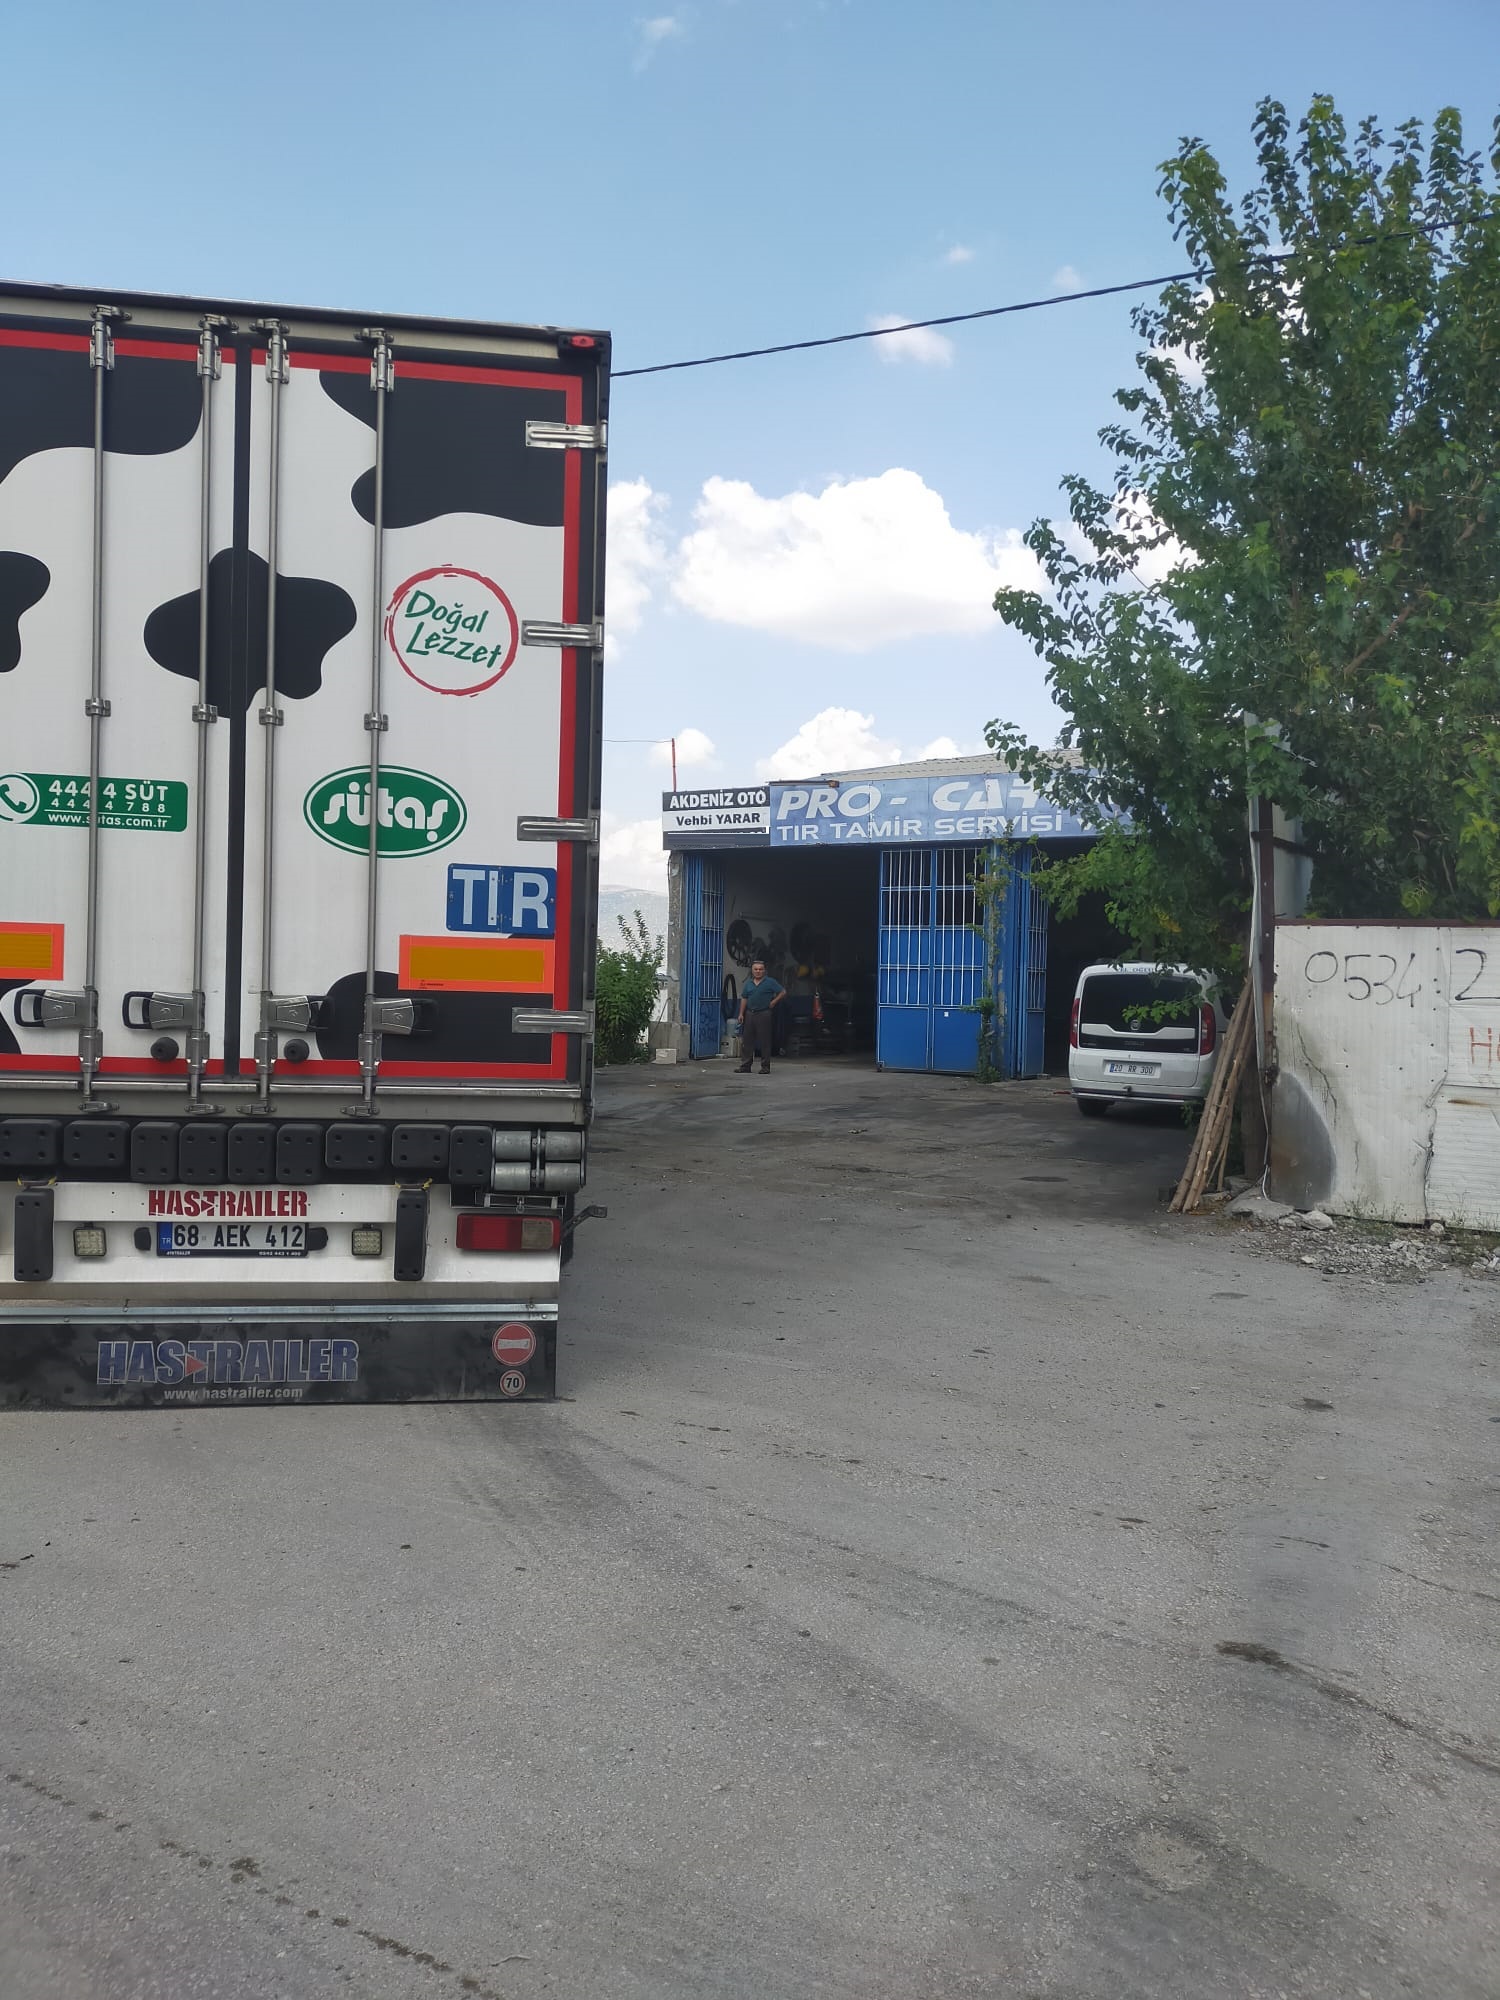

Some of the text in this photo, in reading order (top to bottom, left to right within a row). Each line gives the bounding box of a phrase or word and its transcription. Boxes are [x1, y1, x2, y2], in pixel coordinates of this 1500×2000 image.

[405, 590, 489, 634] Doğal
[406, 621, 502, 668] Lezzet
[125, 780, 169, 802] SÜT
[670, 789, 767, 809] AKDENİZ OTO
[48, 813, 169, 829] www.stas.com.tr
[324, 782, 449, 842] sütaş
[676, 813, 761, 827] Vehbi YARAR
[776, 823, 820, 841] TIR
[829, 816, 922, 840] TAMİR
[934, 810, 1063, 836] SERVİSİ
[452, 869, 549, 929] TIR
[1305, 951, 1421, 1008] 0534
[1469, 1027, 1500, 1070] H
[148, 1190, 308, 1217] HASTRAILER
[174, 1225, 200, 1247] 68
[214, 1225, 251, 1247] AEK
[265, 1225, 303, 1247] 412
[96, 1339, 359, 1385] HASTRAILER
[506, 1377, 519, 1389] 70
